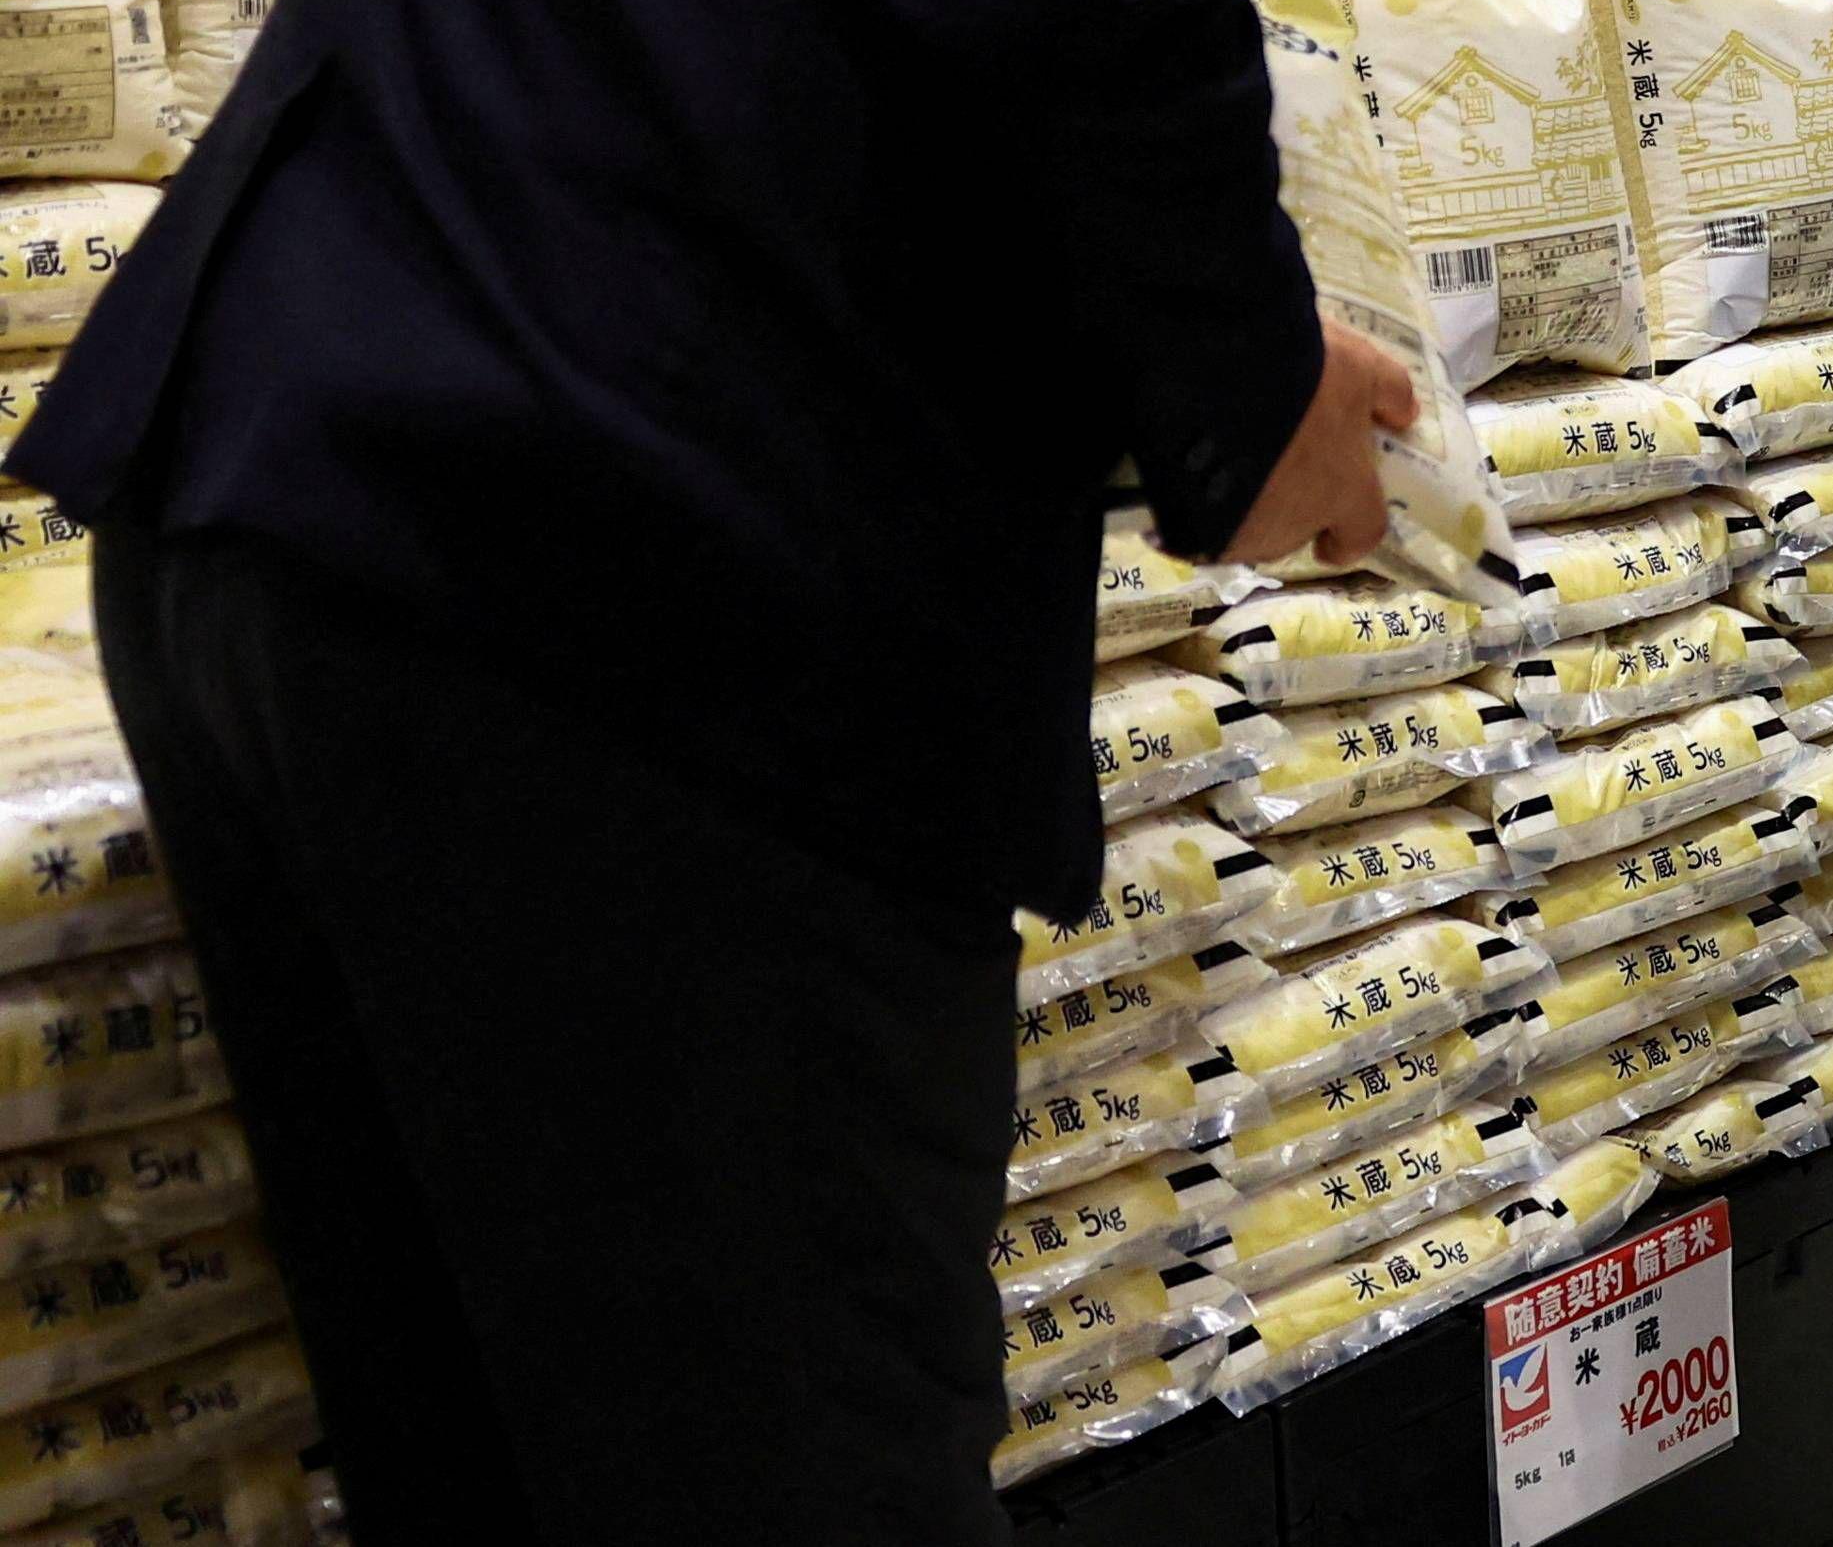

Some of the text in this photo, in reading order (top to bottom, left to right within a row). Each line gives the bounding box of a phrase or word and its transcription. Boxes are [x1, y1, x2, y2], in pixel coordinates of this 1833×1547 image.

[1627, 39, 1661, 102] 米蔵
[1460, 135, 1506, 168] 5kg
[1638, 112, 1664, 149] 5kg
[1731, 112, 1775, 142] 5kg
[1563, 420, 1657, 457] 米蔵 5kg
[1615, 544, 1671, 582] 米蔵
[1411, 604, 1446, 635] 5kg
[1127, 726, 1173, 763] 5kg
[1337, 714, 1440, 764] 米蔵 5kg
[1622, 740, 1727, 793] 米蔵 5kg
[1321, 841, 1437, 888] 米蔵 5kg
[1616, 839, 1723, 891] 米蔵 5kg
[1121, 883, 1166, 920] 5kg
[1615, 933, 1721, 988] 米蔵 5kg
[1018, 978, 1152, 1046] 米蔵 5kg
[1322, 965, 1441, 1031] 米蔵 5kg
[1606, 1025, 1712, 1081] 米蔵 5kg
[1320, 1050, 1439, 1112] 米蔵 5kg
[1011, 1088, 1141, 1147] 米蔵 5kg
[1693, 1128, 1732, 1159] 5kg
[1320, 1146, 1443, 1212] 米蔵 5kg
[989, 1204, 1127, 1268] 米蔵 5kg
[1348, 1239, 1470, 1302] 米蔵 5kg
[1504, 1216, 1716, 1347] 随意契約 備蓄米
[1070, 1293, 1116, 1331] 5kg
[1620, 1335, 1731, 1436] ¥2000
[1514, 1465, 1543, 1492] 5kg
